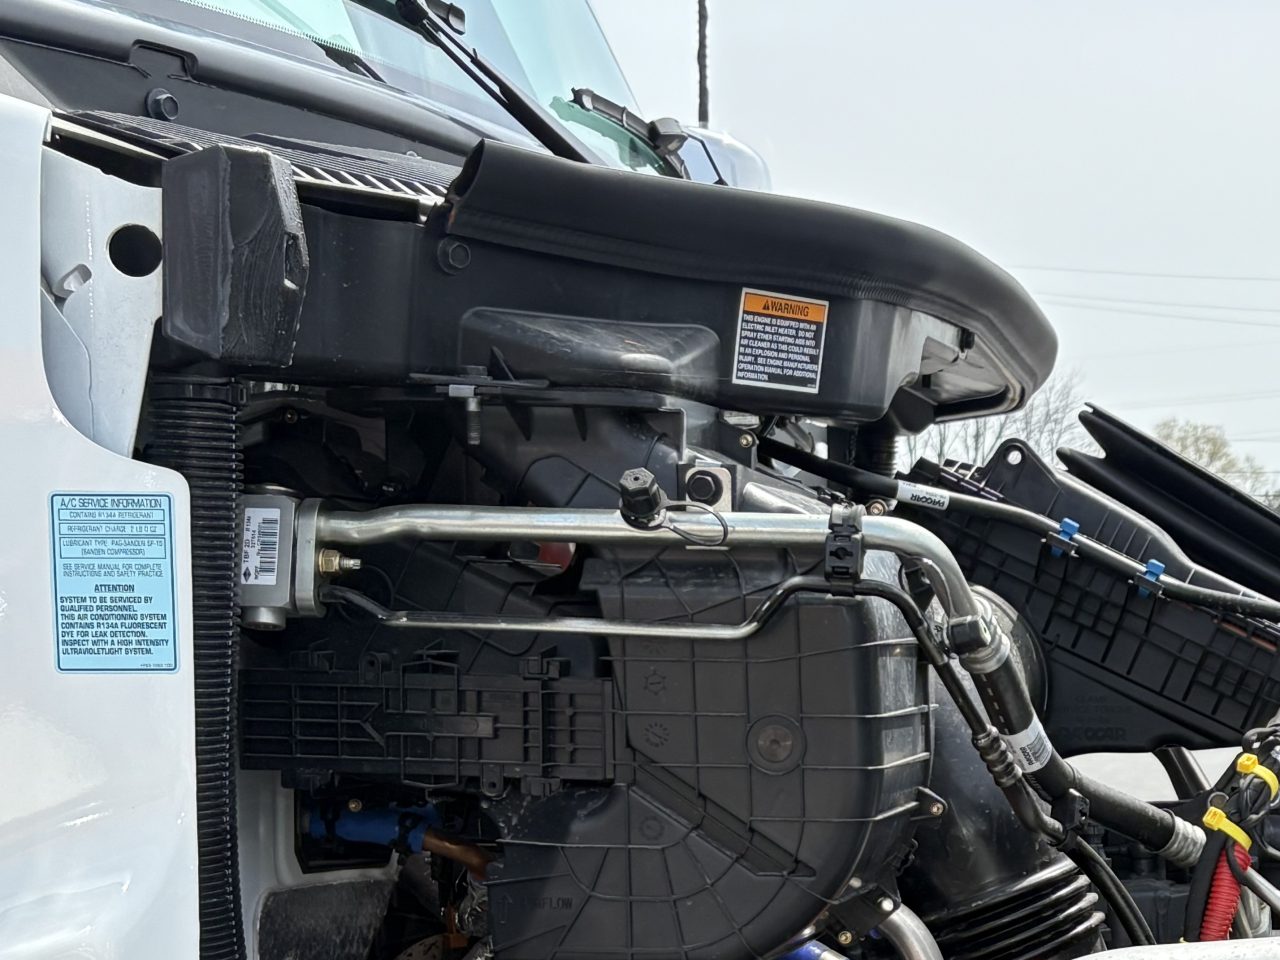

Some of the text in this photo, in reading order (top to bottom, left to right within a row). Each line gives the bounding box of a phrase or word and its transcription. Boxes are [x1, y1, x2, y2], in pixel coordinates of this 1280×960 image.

[771, 301, 809, 317] WARNING
[60, 498, 161, 508] A/C SERVICE INFORMATION
[911, 493, 946, 508] PACCAR
